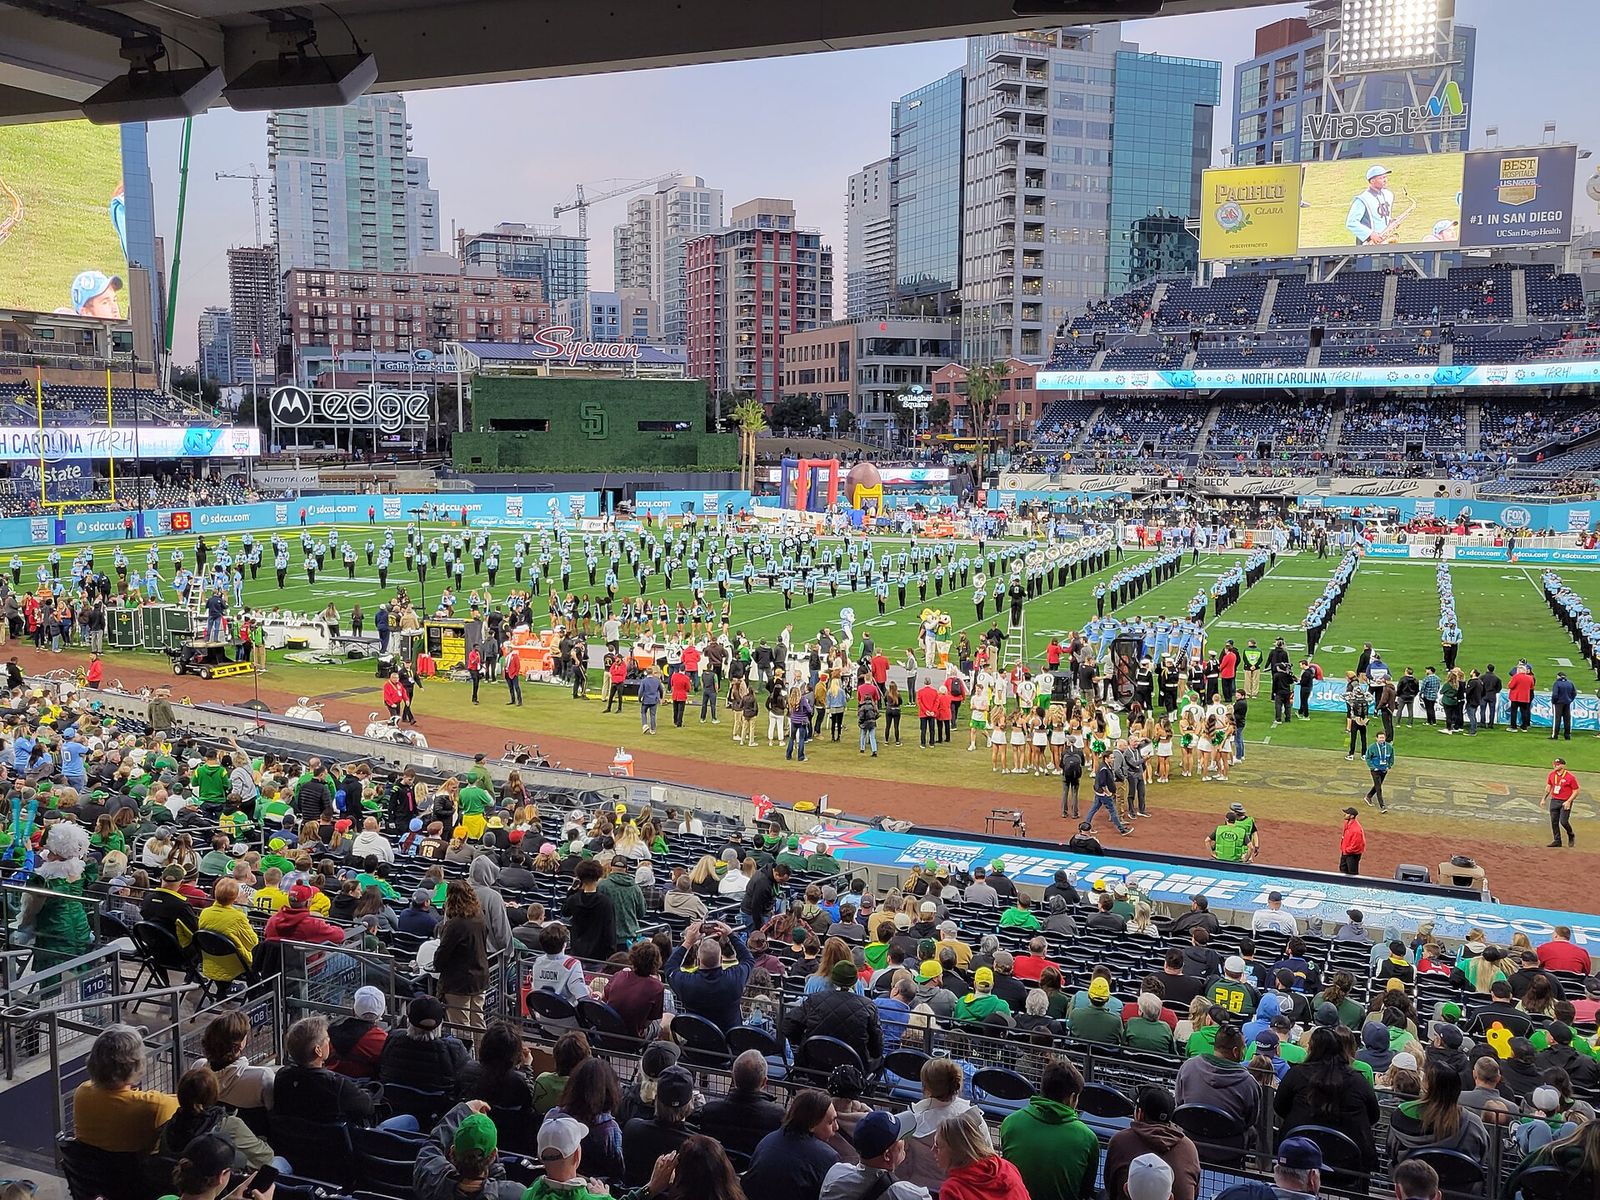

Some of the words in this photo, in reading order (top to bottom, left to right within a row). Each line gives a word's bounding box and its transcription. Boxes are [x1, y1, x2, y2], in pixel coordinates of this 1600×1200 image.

[1307, 107, 1414, 141] Viasat
[1504, 160, 1535, 170] BEST
[1502, 170, 1535, 178] HOSPITALS
[1255, 206, 1283, 215] CLARA
[1470, 215, 1483, 224] #1
[1488, 214, 1498, 224] IN
[1502, 213, 1526, 224] SAN
[1530, 211, 1562, 222] DIEGO
[1521, 228, 1539, 236] Diego
[532, 326, 642, 366] Sycuan
[1242, 374, 1273, 384] NORTH
[1277, 372, 1326, 384] CAROLINA
[898, 394, 933, 402] Gallagher
[321, 384, 430, 433] edge
[902, 401, 928, 409] Square
[12, 433, 82, 454] CAROLINA
[21, 464, 82, 482] Allstate
[1079, 476, 1129, 491] Templeton
[1141, 478, 1158, 486] THE
[1204, 478, 1229, 486] DECK
[1242, 480, 1296, 494] Templeton
[1350, 480, 1418, 496] Templeton
[316, 504, 356, 514] sdccu.com
[434, 503, 481, 512] sdccu.om
[175, 514, 188, 528] 25
[210, 514, 248, 523] sdccu.com
[1506, 510, 1524, 520] FOX
[983, 852, 1249, 899] WELCOME
[1253, 883, 1326, 909] TO
[343, 972, 355, 982] 110
[86, 979, 104, 992] 110
[1216, 988, 1244, 1012] 28
